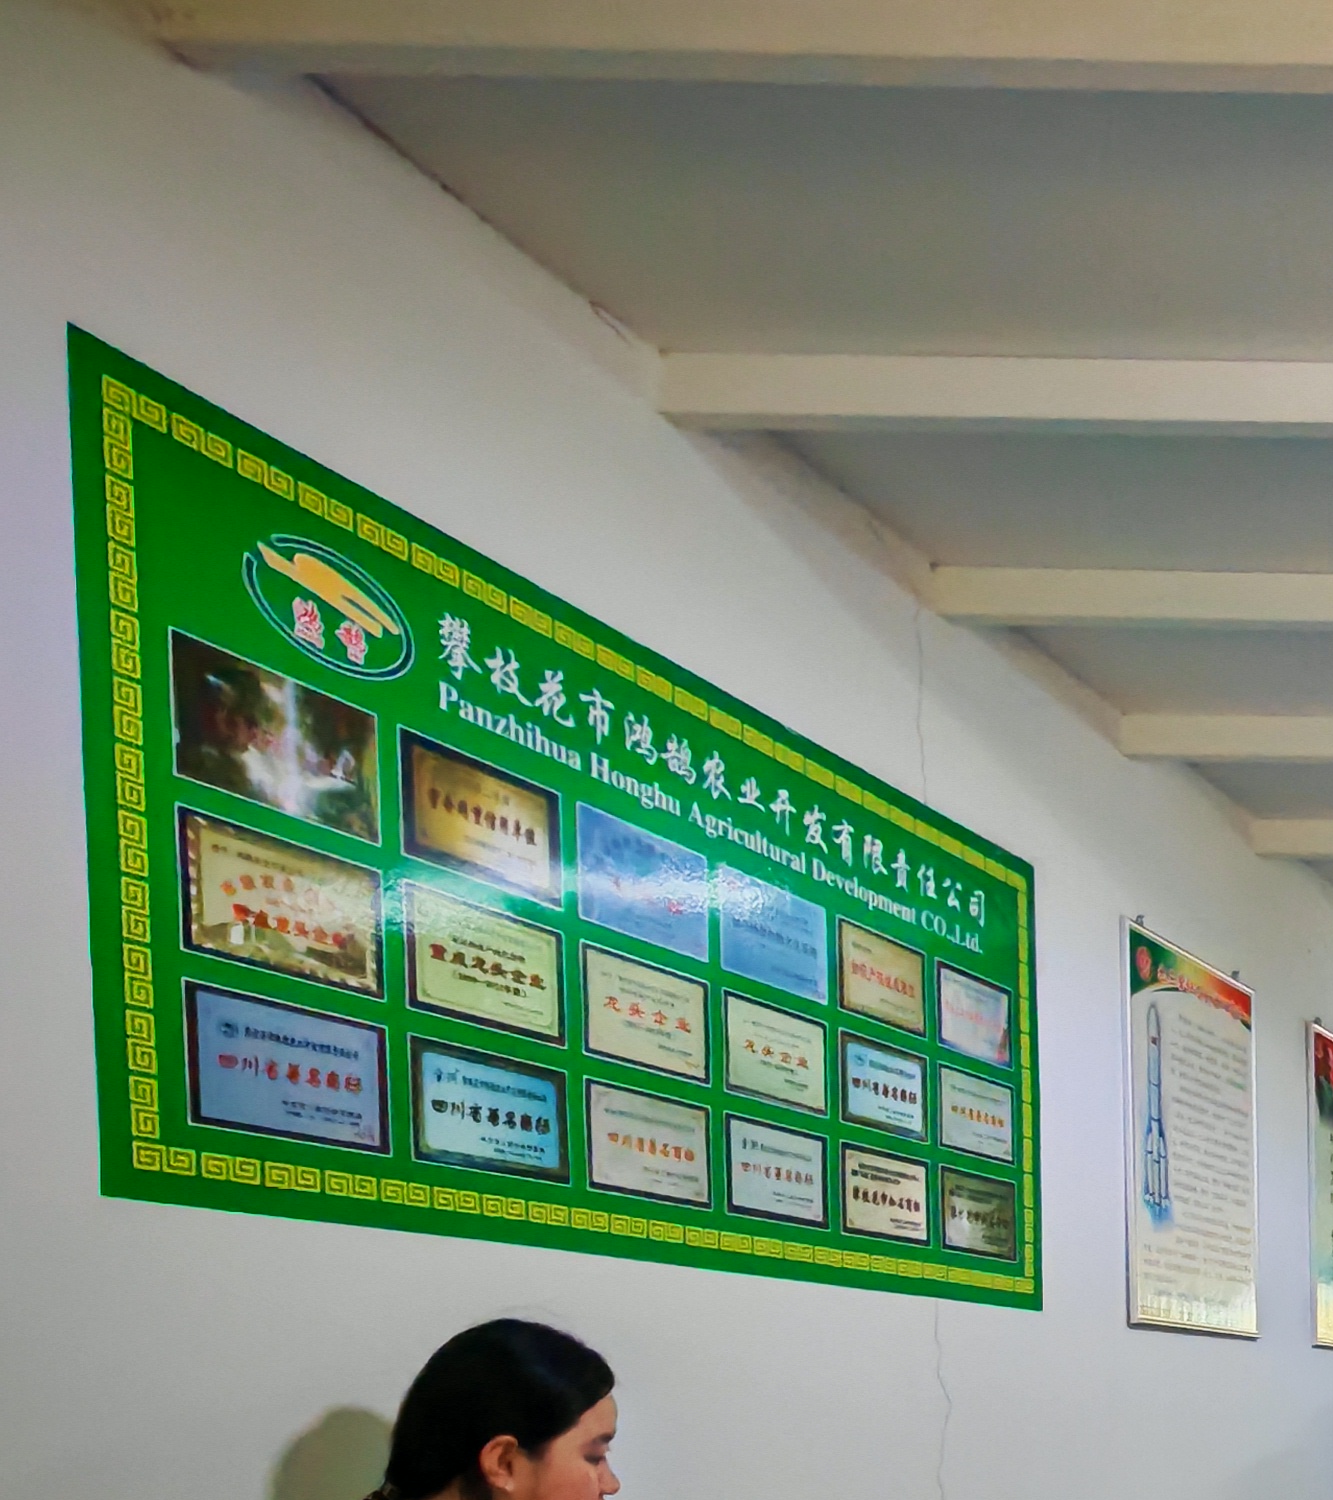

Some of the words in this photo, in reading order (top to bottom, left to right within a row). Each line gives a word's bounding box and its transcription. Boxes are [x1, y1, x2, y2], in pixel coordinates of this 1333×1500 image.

[438, 680, 582, 772] Panzhihua
[590, 752, 681, 817] Honghu
[687, 801, 806, 875] Agricultural
[812, 858, 917, 926] Development
